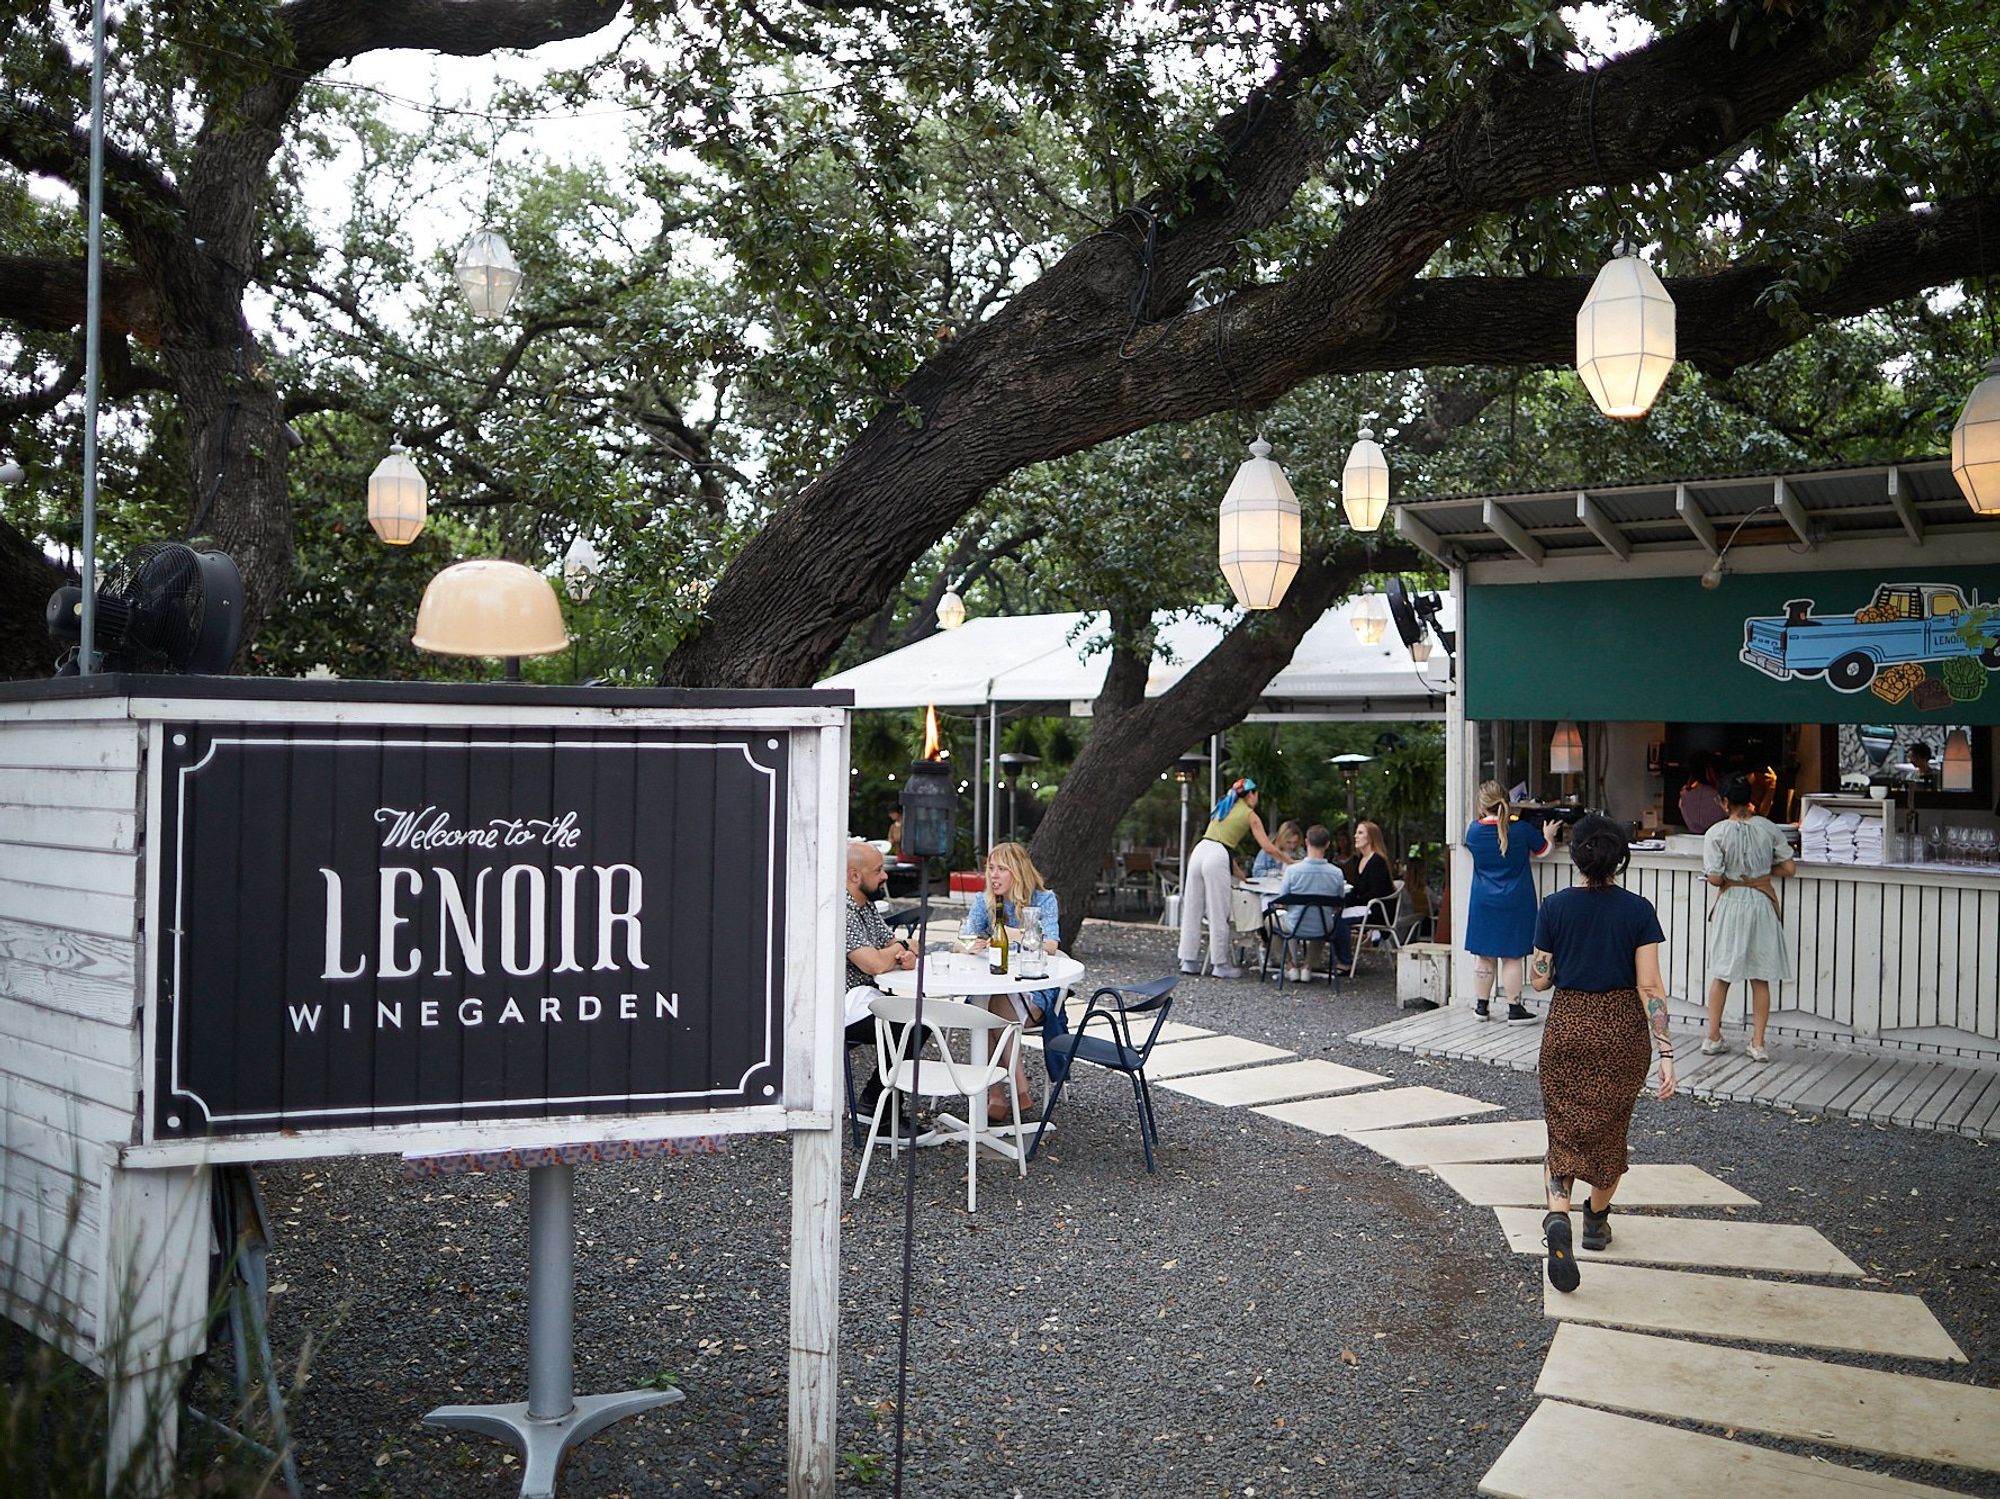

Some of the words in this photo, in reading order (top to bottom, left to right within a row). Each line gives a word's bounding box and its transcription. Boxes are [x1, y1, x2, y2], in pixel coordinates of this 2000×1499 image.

[374, 805, 500, 850] Welcome
[489, 818, 536, 846] to
[527, 811, 582, 848] the
[318, 863, 650, 979] LENOIR
[288, 991, 680, 1033] WINEGARDEN
